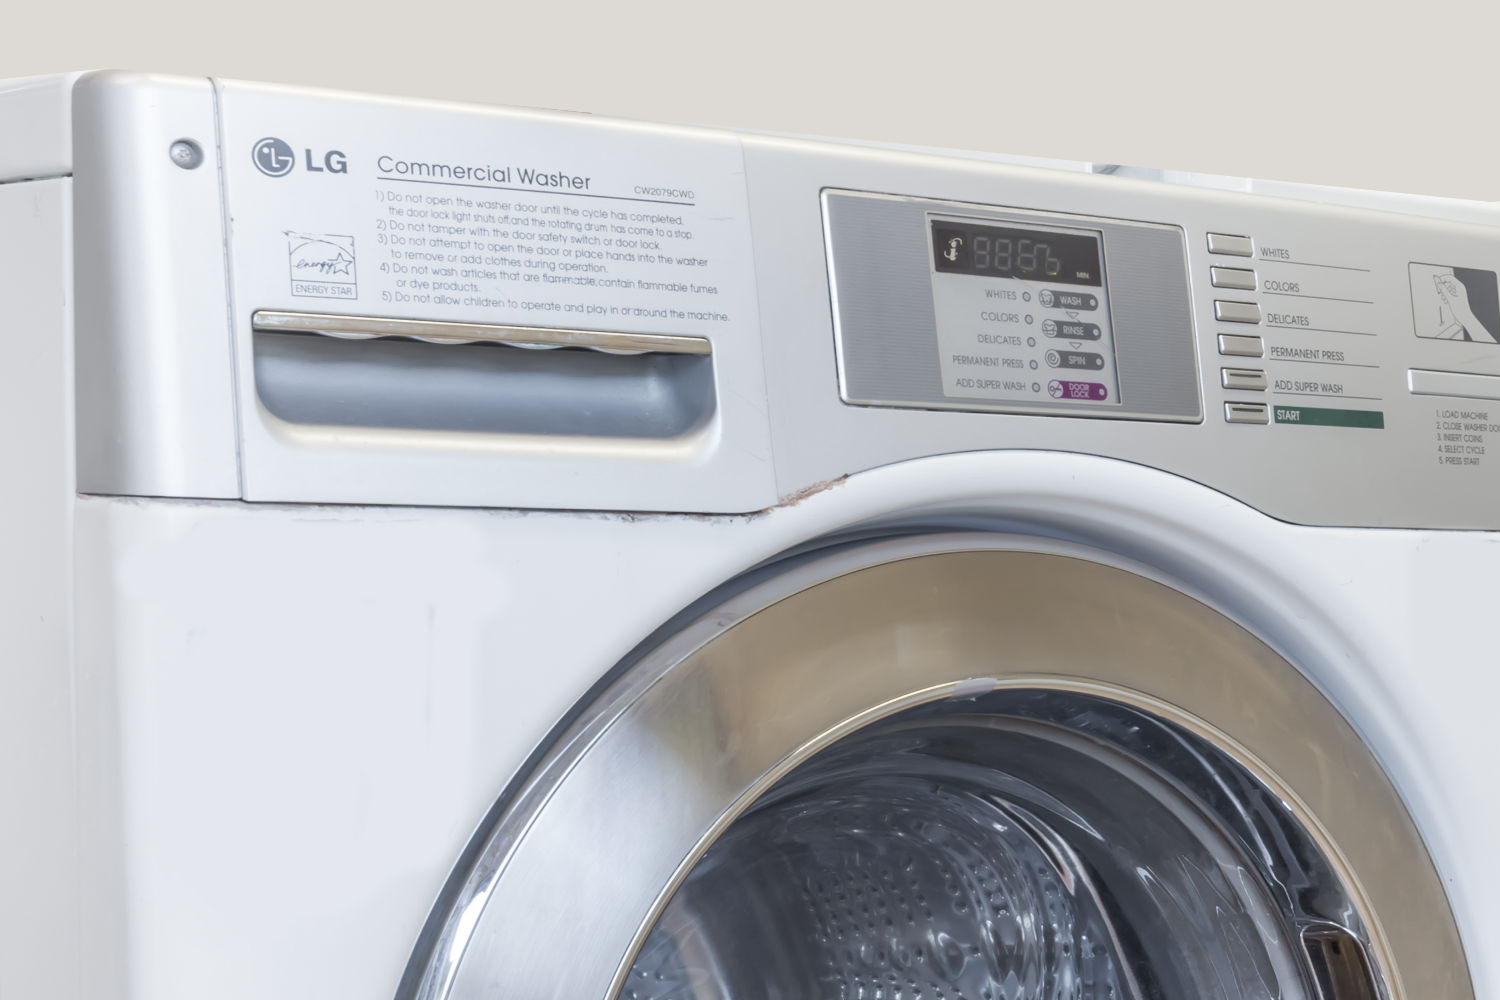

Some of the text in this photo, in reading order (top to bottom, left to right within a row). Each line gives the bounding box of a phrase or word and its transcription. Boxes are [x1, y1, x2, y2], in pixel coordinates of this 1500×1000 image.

[305, 148, 347, 174] LG
[377, 155, 591, 190] Commercial Washer
[634, 185, 695, 200] CW2079CWD
[375, 190, 384, 202] 1)
[388, 191, 402, 201] Do
[406, 194, 422, 203] not
[425, 196, 453, 207] open
[456, 197, 472, 207] the
[476, 200, 511, 211] washer
[514, 202, 538, 213] door
[540, 204, 560, 215] until
[563, 206, 579, 216] the
[583, 208, 608, 220] cycle
[611, 210, 627, 221] has
[388, 205, 403, 216] the
[407, 207, 429, 218] door
[431, 209, 449, 219] lock
[452, 211, 471, 223] light
[473, 213, 495, 224] shuts
[532, 216, 545, 227] the
[548, 218, 582, 232] rotating
[584, 221, 607, 233] drum
[610, 223, 626, 234] has
[628, 226, 653, 236] come
[656, 227, 664, 237] to
[666, 230, 673, 238] a
[376, 219, 386, 231] 2)
[389, 220, 404, 230] Do
[407, 222, 424, 232] not
[428, 223, 466, 236] tamper
[469, 226, 489, 236] with
[493, 228, 508, 238] the
[512, 229, 535, 240] door
[539, 231, 567, 244] safety
[570, 235, 600, 246] switch
[603, 238, 613, 247] or
[616, 237, 638, 248] door
[377, 234, 708, 267] 3) Do not attempt to open the door or place hands into the washer
[1261, 248, 1290, 259] WHITES
[391, 249, 401, 259] to
[405, 251, 444, 262] remove
[447, 253, 457, 262] or
[460, 254, 482, 264] add
[485, 256, 521, 268] clothes
[524, 258, 556, 271] during
[380, 262, 390, 273] 4)
[393, 263, 408, 273] Do
[411, 265, 428, 275] not
[431, 266, 457, 277] wash
[460, 268, 497, 280] articles
[500, 271, 520, 281] that
[523, 273, 539, 282] are
[638, 280, 687, 292] flammable
[295, 284, 352, 296] ENERGY STAR
[396, 279, 407, 288] or
[409, 279, 429, 290] dye
[1264, 280, 1300, 292] COLORS
[985, 289, 1016, 300] WHITES
[1060, 295, 1082, 305] WASH
[382, 291, 392, 302] 5)
[395, 292, 410, 302] Do
[413, 294, 430, 303] not
[433, 295, 460, 305] allow
[464, 296, 505, 308] children
[507, 299, 518, 308] to
[521, 300, 561, 312] operate
[564, 302, 583, 313] and
[587, 304, 607, 316] play
[610, 306, 618, 315] in
[670, 309, 685, 319] the
[981, 312, 1019, 323] COLORS
[1267, 313, 1310, 326] DELICATES
[1063, 326, 1084, 336] RINSE
[977, 334, 1022, 345] DELICATES
[1068, 356, 1086, 365] SPIN
[1271, 347, 1345, 361] PERMANENT PRESS
[953, 355, 1024, 368] PERMANENT PRESS
[956, 378, 1026, 391] ADD SUPER WASH
[1069, 383, 1090, 391] DOOR
[1274, 380, 1344, 394] ADD SUPER WASH
[1071, 390, 1090, 398] LOCK
[1277, 410, 1300, 421] START
